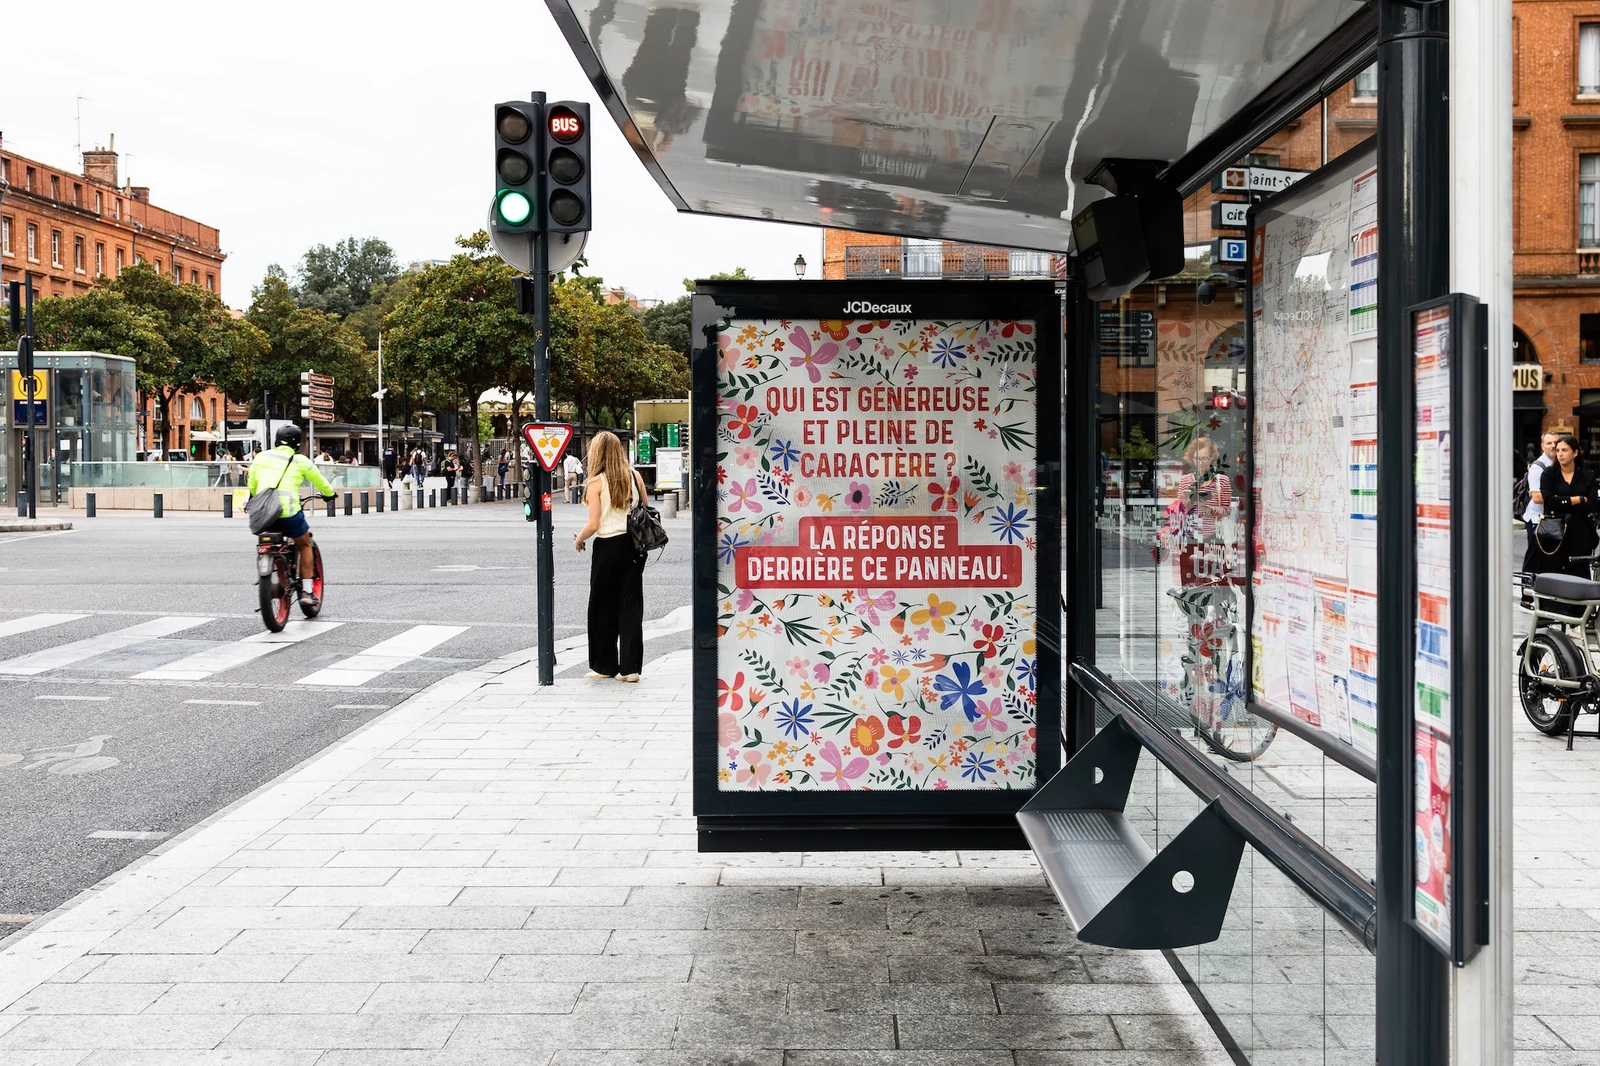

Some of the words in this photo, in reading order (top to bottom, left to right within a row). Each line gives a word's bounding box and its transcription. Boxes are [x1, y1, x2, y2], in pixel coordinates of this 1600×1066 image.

[552, 118, 579, 132] BUS
[843, 301, 912, 314] JCDecaux
[766, 386, 805, 416] QUI
[812, 386, 851, 411] EST
[858, 380, 990, 412] GÉNÉREUSE
[803, 419, 829, 445] ET
[837, 419, 917, 444] PLEINE
[926, 419, 953, 444] DE
[800, 447, 937, 478] CARACTÈRE
[809, 525, 836, 550] LA
[843, 519, 946, 550] RÉPONSE
[747, 551, 855, 581] DERRIÈRE
[861, 556, 888, 581] CE
[895, 555, 1009, 580] PANNEAU.
